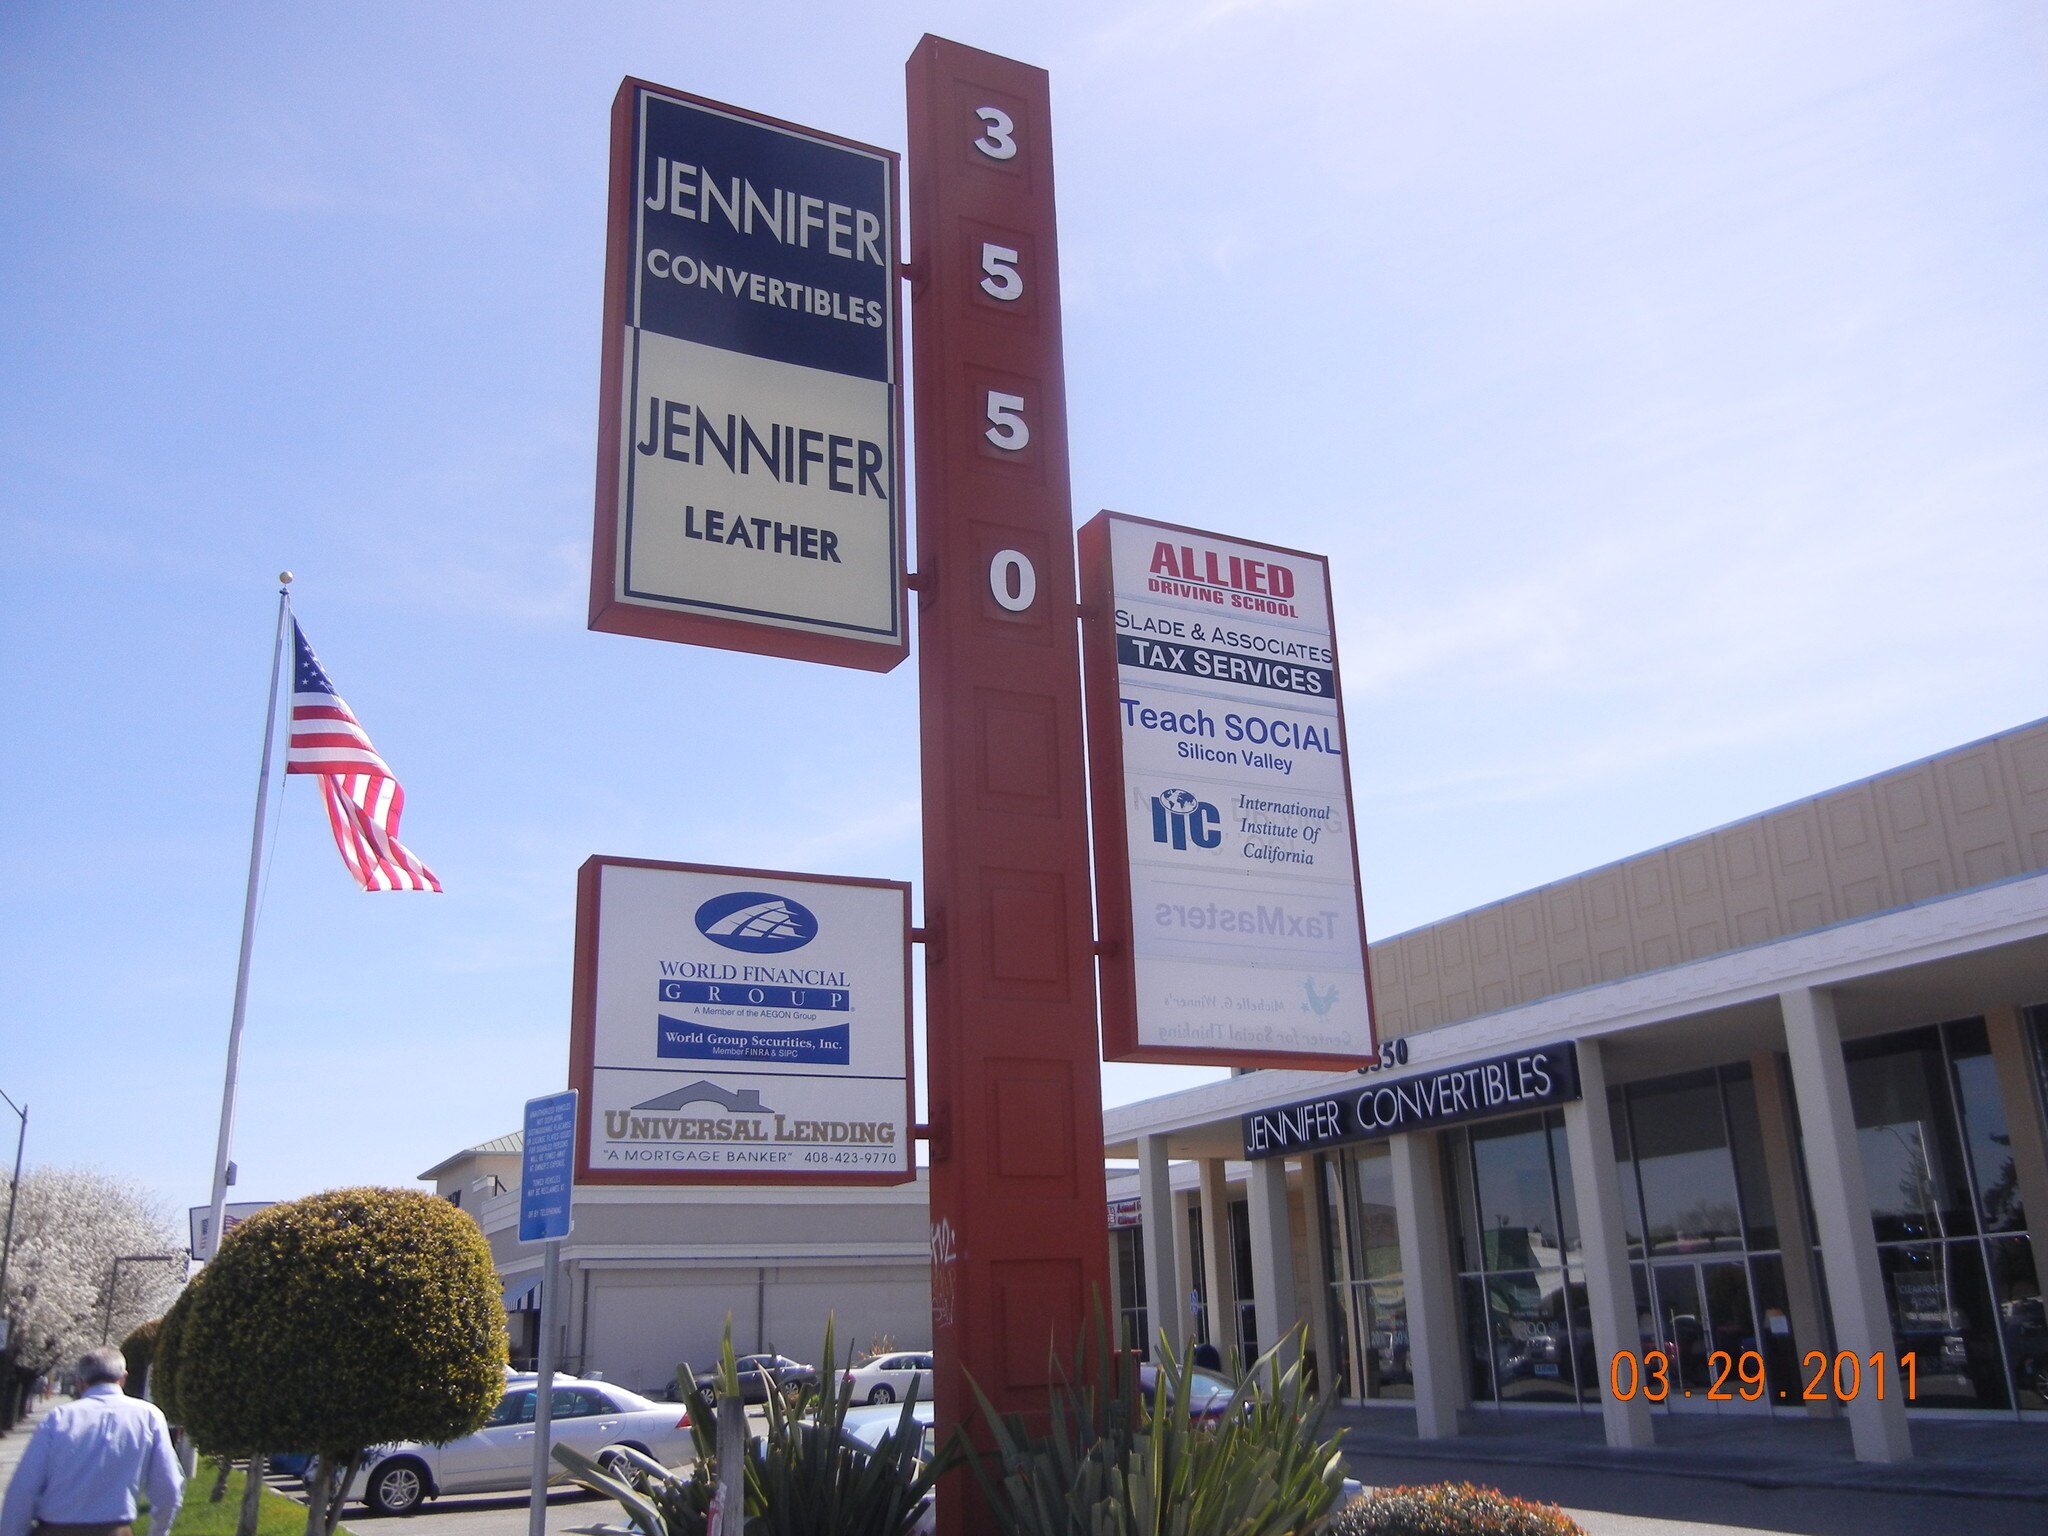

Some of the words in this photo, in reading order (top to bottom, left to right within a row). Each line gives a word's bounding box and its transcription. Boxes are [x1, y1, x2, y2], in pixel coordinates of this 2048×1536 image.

[975, 107, 1017, 161] 3
[645, 157, 884, 266] JENNIFER
[647, 249, 883, 328] CONVERTIBLES
[980, 243, 1024, 301] 5
[984, 390, 1030, 451] 5
[637, 396, 887, 500] JENNIFER
[685, 505, 841, 564] LEATHER
[989, 549, 1037, 613] 0
[1149, 541, 1295, 599] ALLIED
[1148, 577, 1224, 605] DRIVING
[1231, 594, 1298, 619] SCHOOL
[1115, 610, 1186, 638] SLADE
[1191, 623, 1206, 641] &
[1211, 627, 1333, 664] ASSOCIATES
[1132, 640, 1187, 672] TAX
[1193, 650, 1322, 694] SERVICES
[1120, 698, 1215, 738] Teach
[1225, 713, 1341, 755] SOCIAL
[1178, 741, 1237, 764] Silicon
[1242, 750, 1293, 775] Valley
[1239, 794, 1330, 820] International
[1240, 818, 1298, 839] Institute
[1302, 826, 1321, 844] Of
[1243, 843, 1314, 865] California
[659, 960, 737, 980] WORLD
[743, 965, 850, 987] FINANCIAL
[665, 983, 843, 1008] GROUP
[666, 1031, 703, 1044] World
[707, 1033, 748, 1047] Group
[751, 1034, 815, 1049] Securities,
[819, 1039, 843, 1050] Inc.
[702, 1007, 735, 1017] Member
[737, 1009, 745, 1017] of
[746, 1009, 759, 1018] the
[760, 1010, 791, 1019] AEGON
[792, 1012, 817, 1021] Group
[713, 1047, 744, 1056] Member
[745, 1048, 770, 1057] FINRA
[778, 1049, 798, 1058] SIPC
[604, 1110, 768, 1141] UNIVERSAL
[774, 1114, 896, 1144] LENDING
[1247, 1100, 1341, 1152] JENNIFER
[1356, 1053, 1551, 1130] CONVERTIBLES
[624, 1150, 720, 1162] MORTGAGE
[804, 1152, 897, 1164] 408-423-9770
